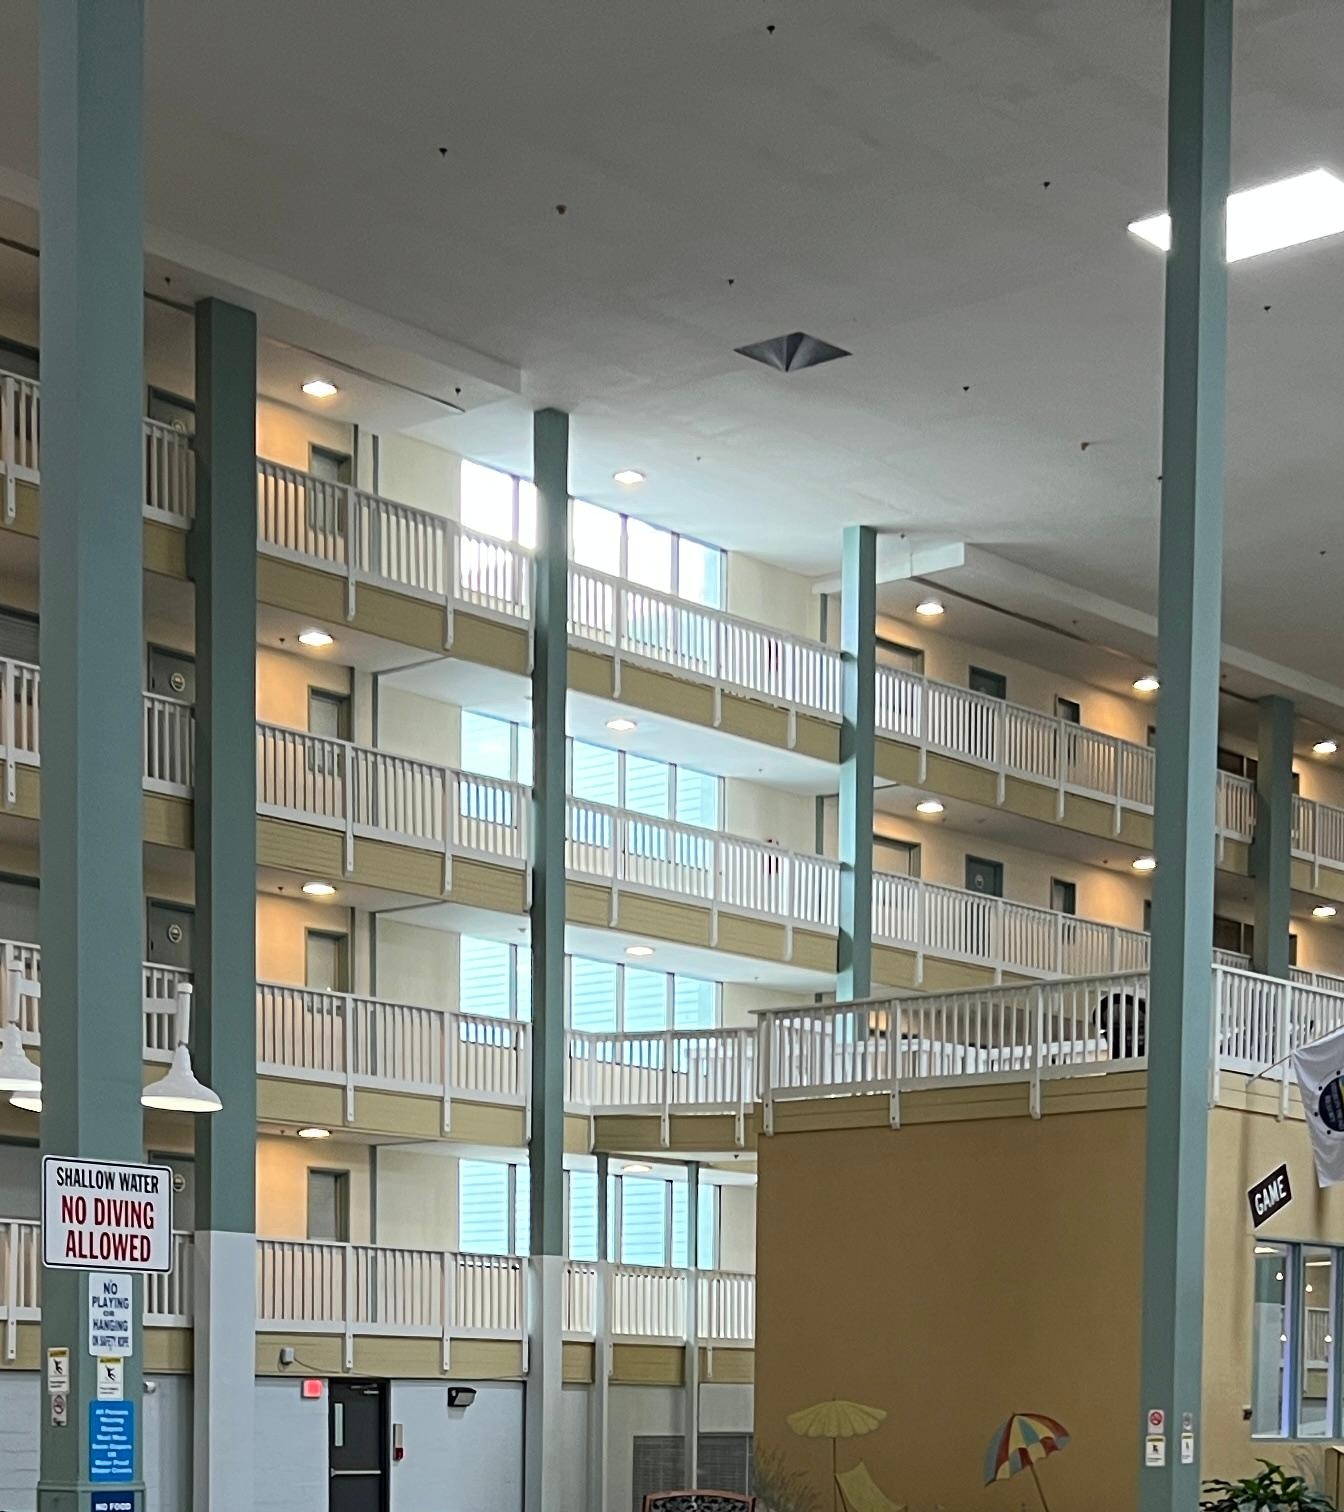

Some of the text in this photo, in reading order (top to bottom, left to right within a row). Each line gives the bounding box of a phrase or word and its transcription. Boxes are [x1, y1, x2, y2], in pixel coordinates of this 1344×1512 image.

[56, 1166, 159, 1194] SHALLOW WATER
[1254, 1174, 1288, 1216] GAME
[61, 1195, 154, 1230] NO DIVING
[65, 1229, 151, 1263] ALLOWED
[103, 1282, 118, 1295] NO
[92, 1296, 129, 1309] PLAYING
[92, 1318, 128, 1331] HANGING
[95, 1502, 132, 1511] NO FOOD
